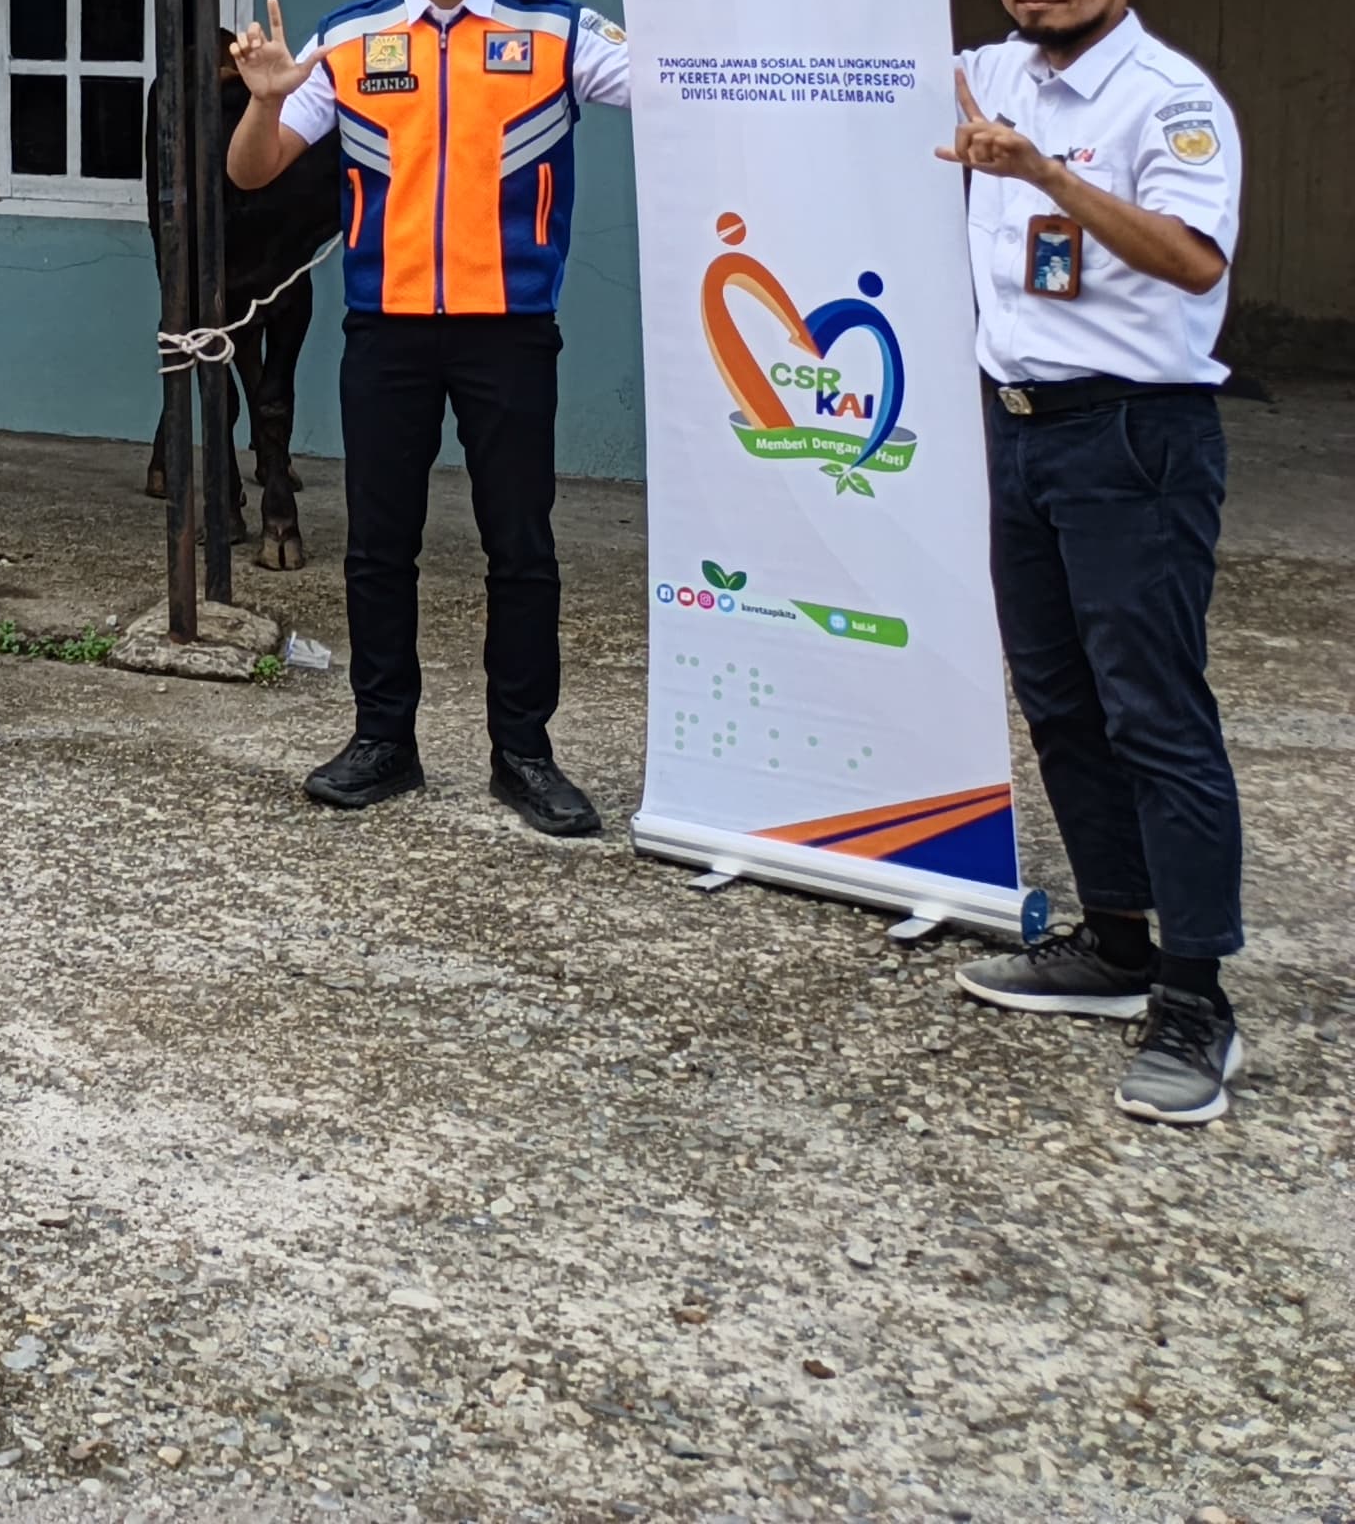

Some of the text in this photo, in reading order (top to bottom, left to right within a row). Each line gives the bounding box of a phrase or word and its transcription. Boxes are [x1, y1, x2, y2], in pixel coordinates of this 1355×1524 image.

[488, 40, 529, 62] KAI
[657, 58, 916, 70] TANGGUNG JAWAB SOSIAL DAN LINGKUNGAN
[659, 72, 916, 89] PT KERETA API INDONESIA (PERSERO)
[681, 87, 895, 104] DIVISI REGIONAL III PALEMBANG
[770, 362, 842, 393] CSR
[816, 390, 874, 419] KAI
[756, 437, 904, 467] Memberi Dengan Hati
